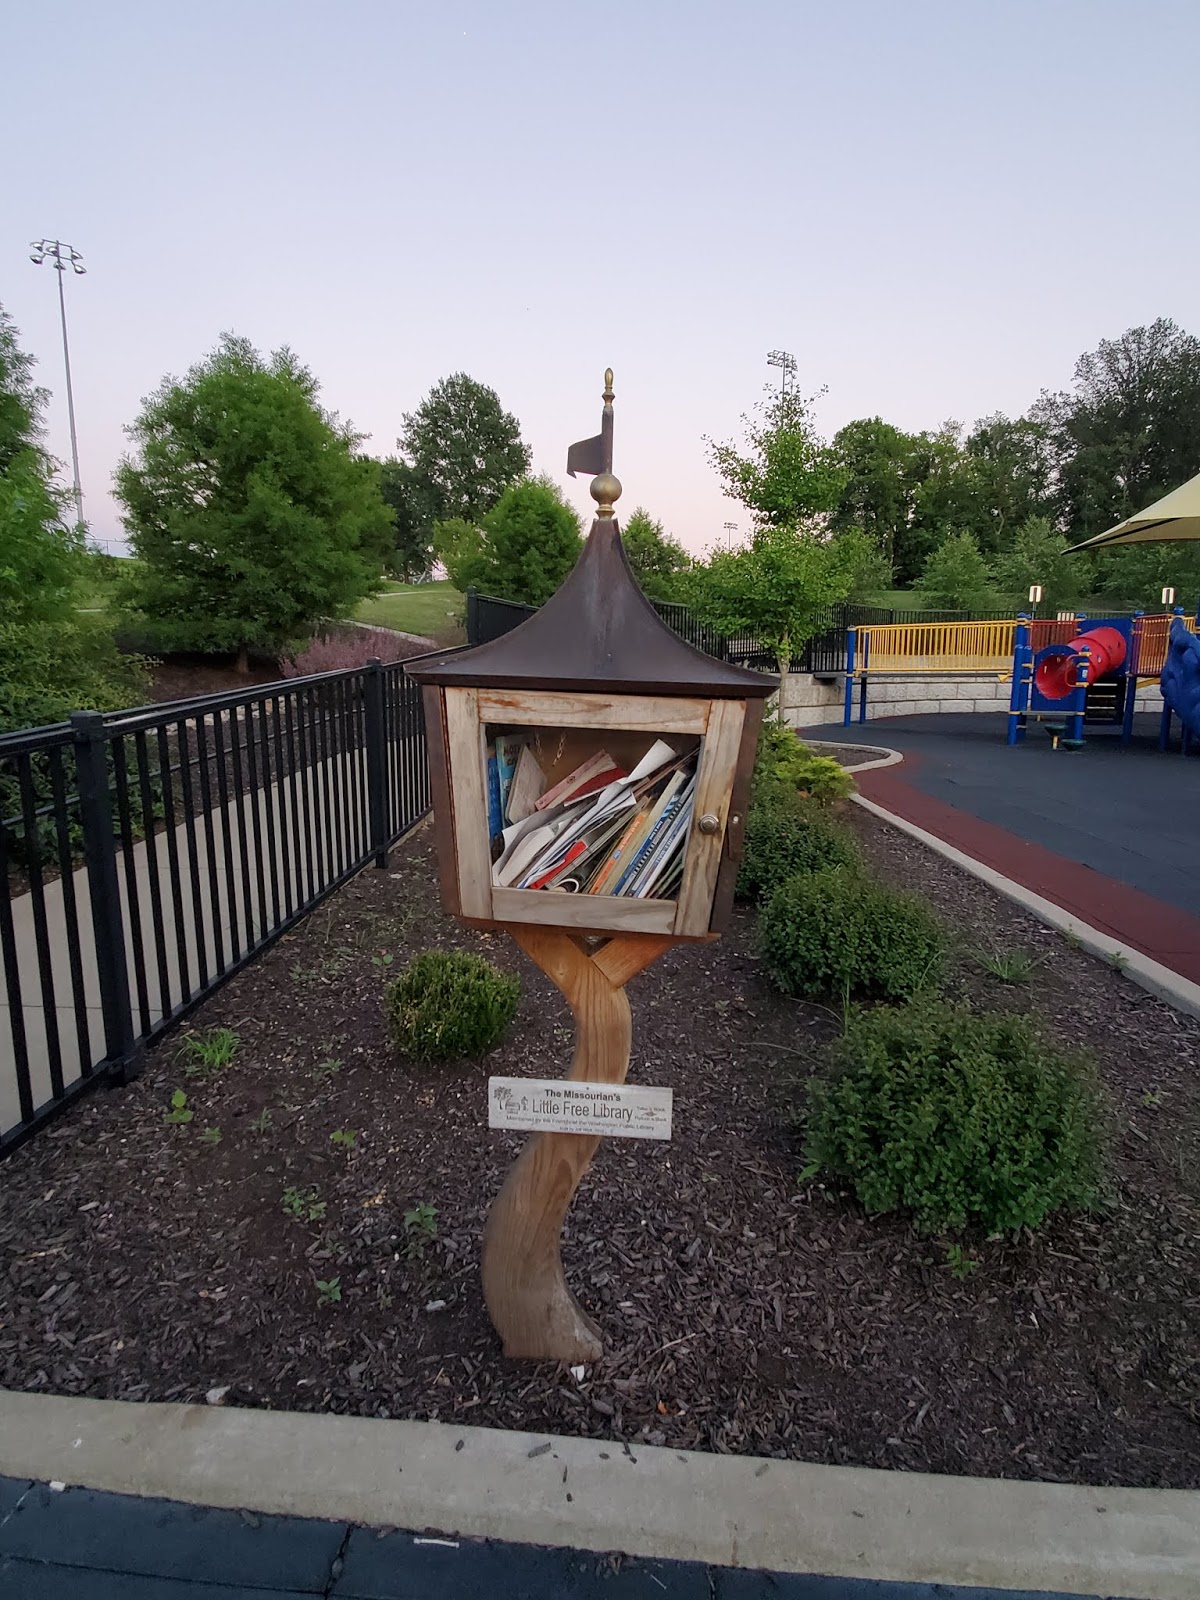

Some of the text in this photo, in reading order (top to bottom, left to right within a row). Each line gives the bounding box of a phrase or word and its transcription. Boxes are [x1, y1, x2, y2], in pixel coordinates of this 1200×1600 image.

[544, 1089, 622, 1102] The Missourian's
[532, 1099, 633, 1123] Little Free Library
